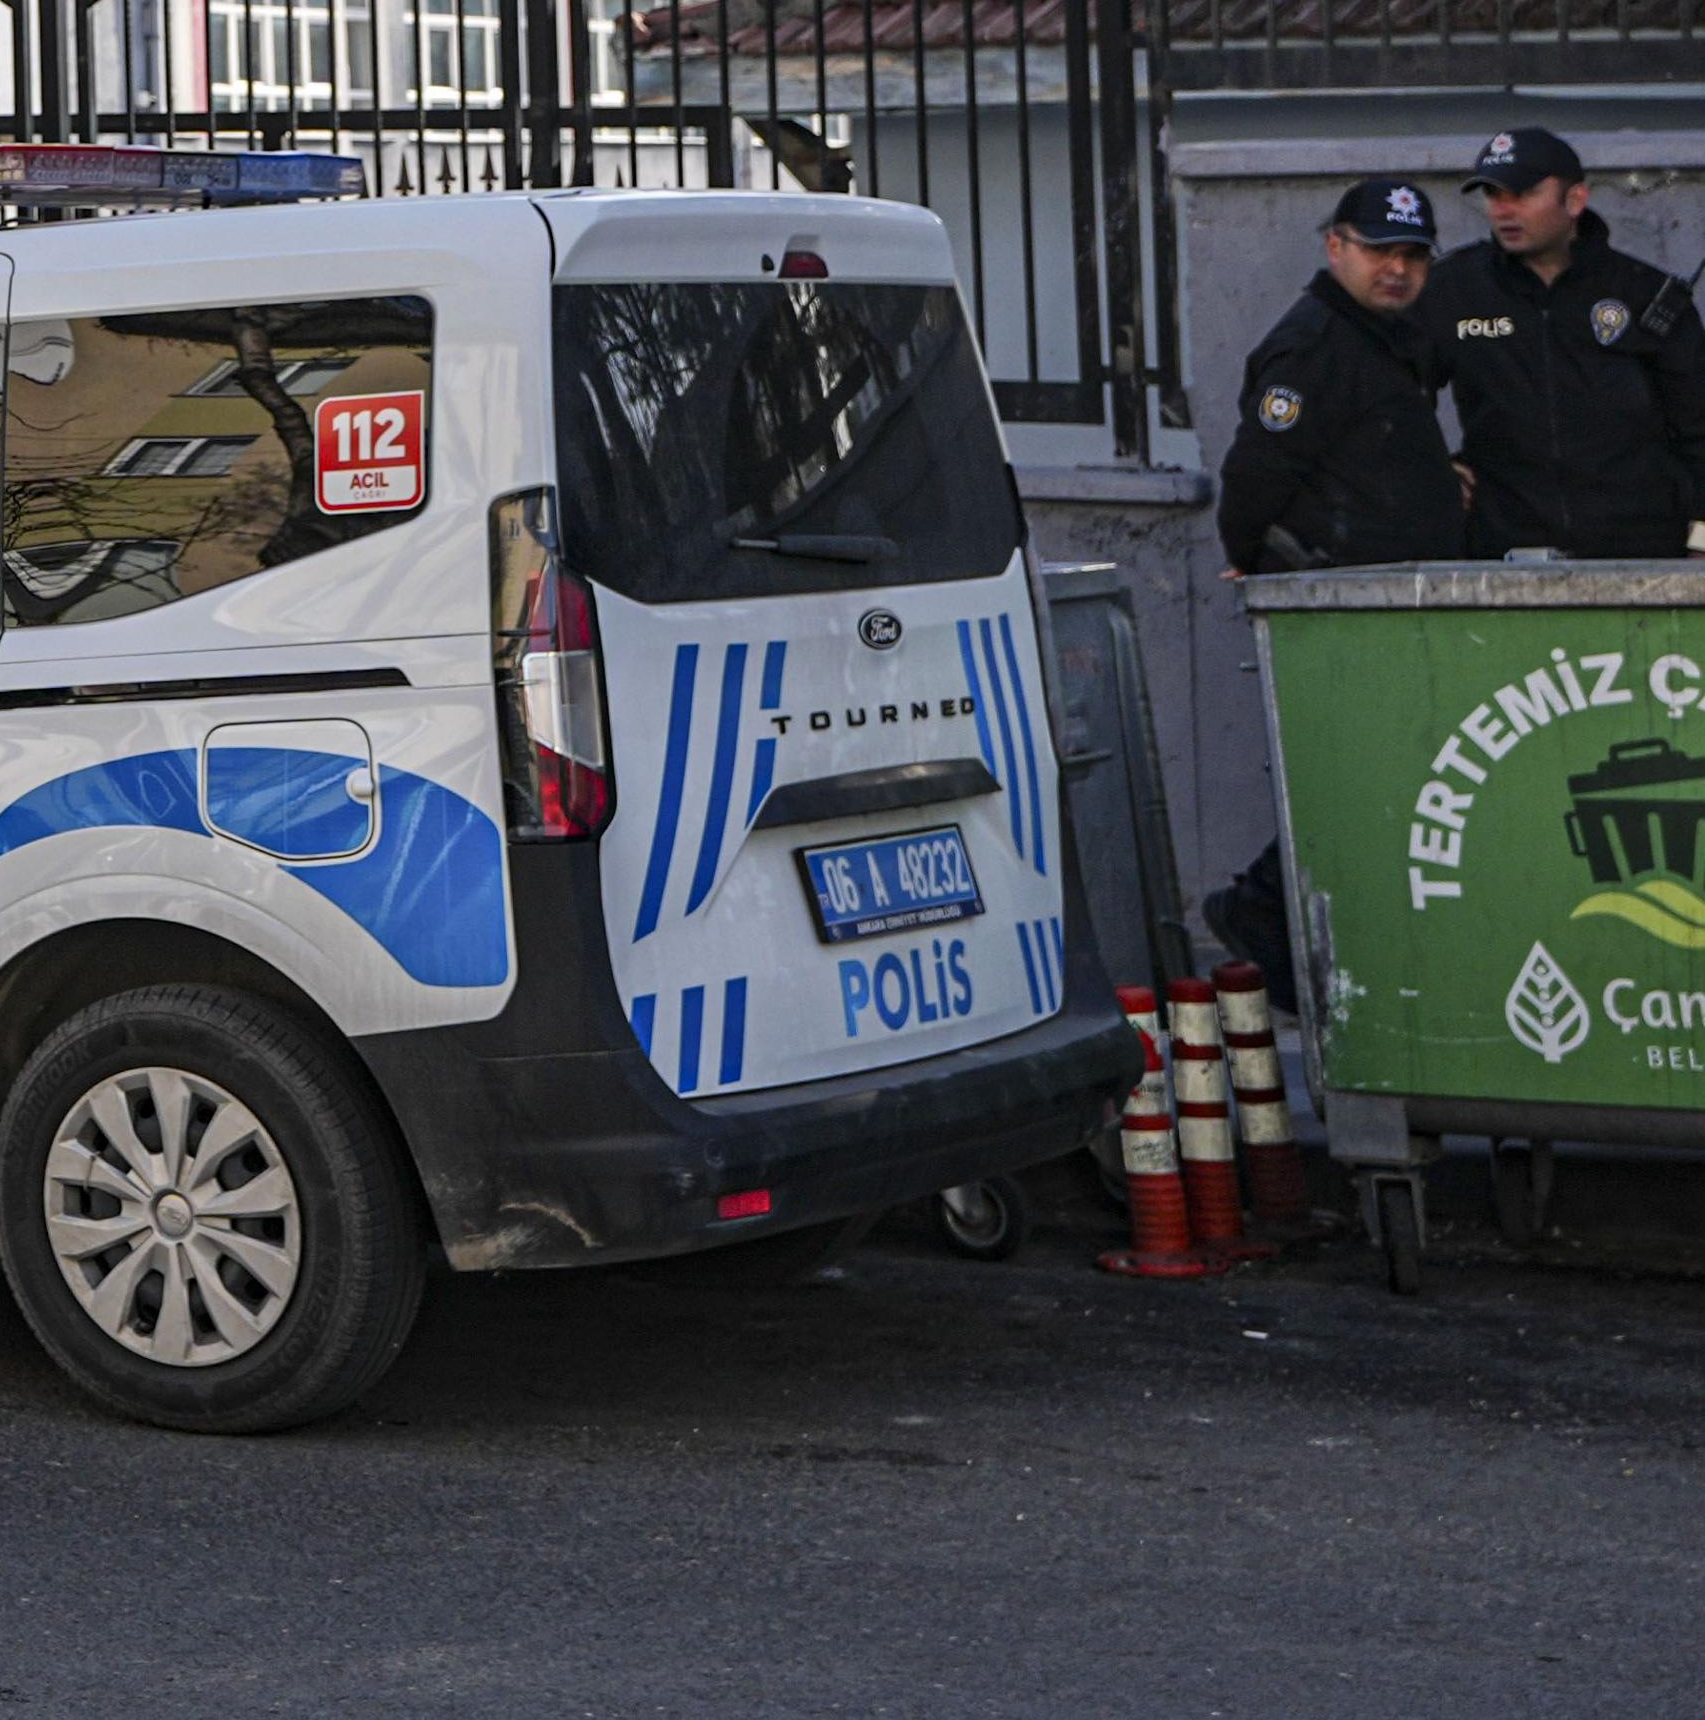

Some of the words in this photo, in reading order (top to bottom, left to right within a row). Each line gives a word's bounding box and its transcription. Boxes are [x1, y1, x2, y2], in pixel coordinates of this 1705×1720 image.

[332, 407, 407, 462] 112
[350, 471, 390, 490] ACİL
[870, 615, 898, 642] Ford
[771, 695, 978, 735] TOURNEO
[1409, 647, 1633, 910] TERTEMİZ
[1649, 653, 1705, 719] Ç
[821, 856, 861, 914] 06
[866, 850, 890, 907] A
[896, 837, 971, 901] 48232
[838, 939, 974, 1037] POLİS
